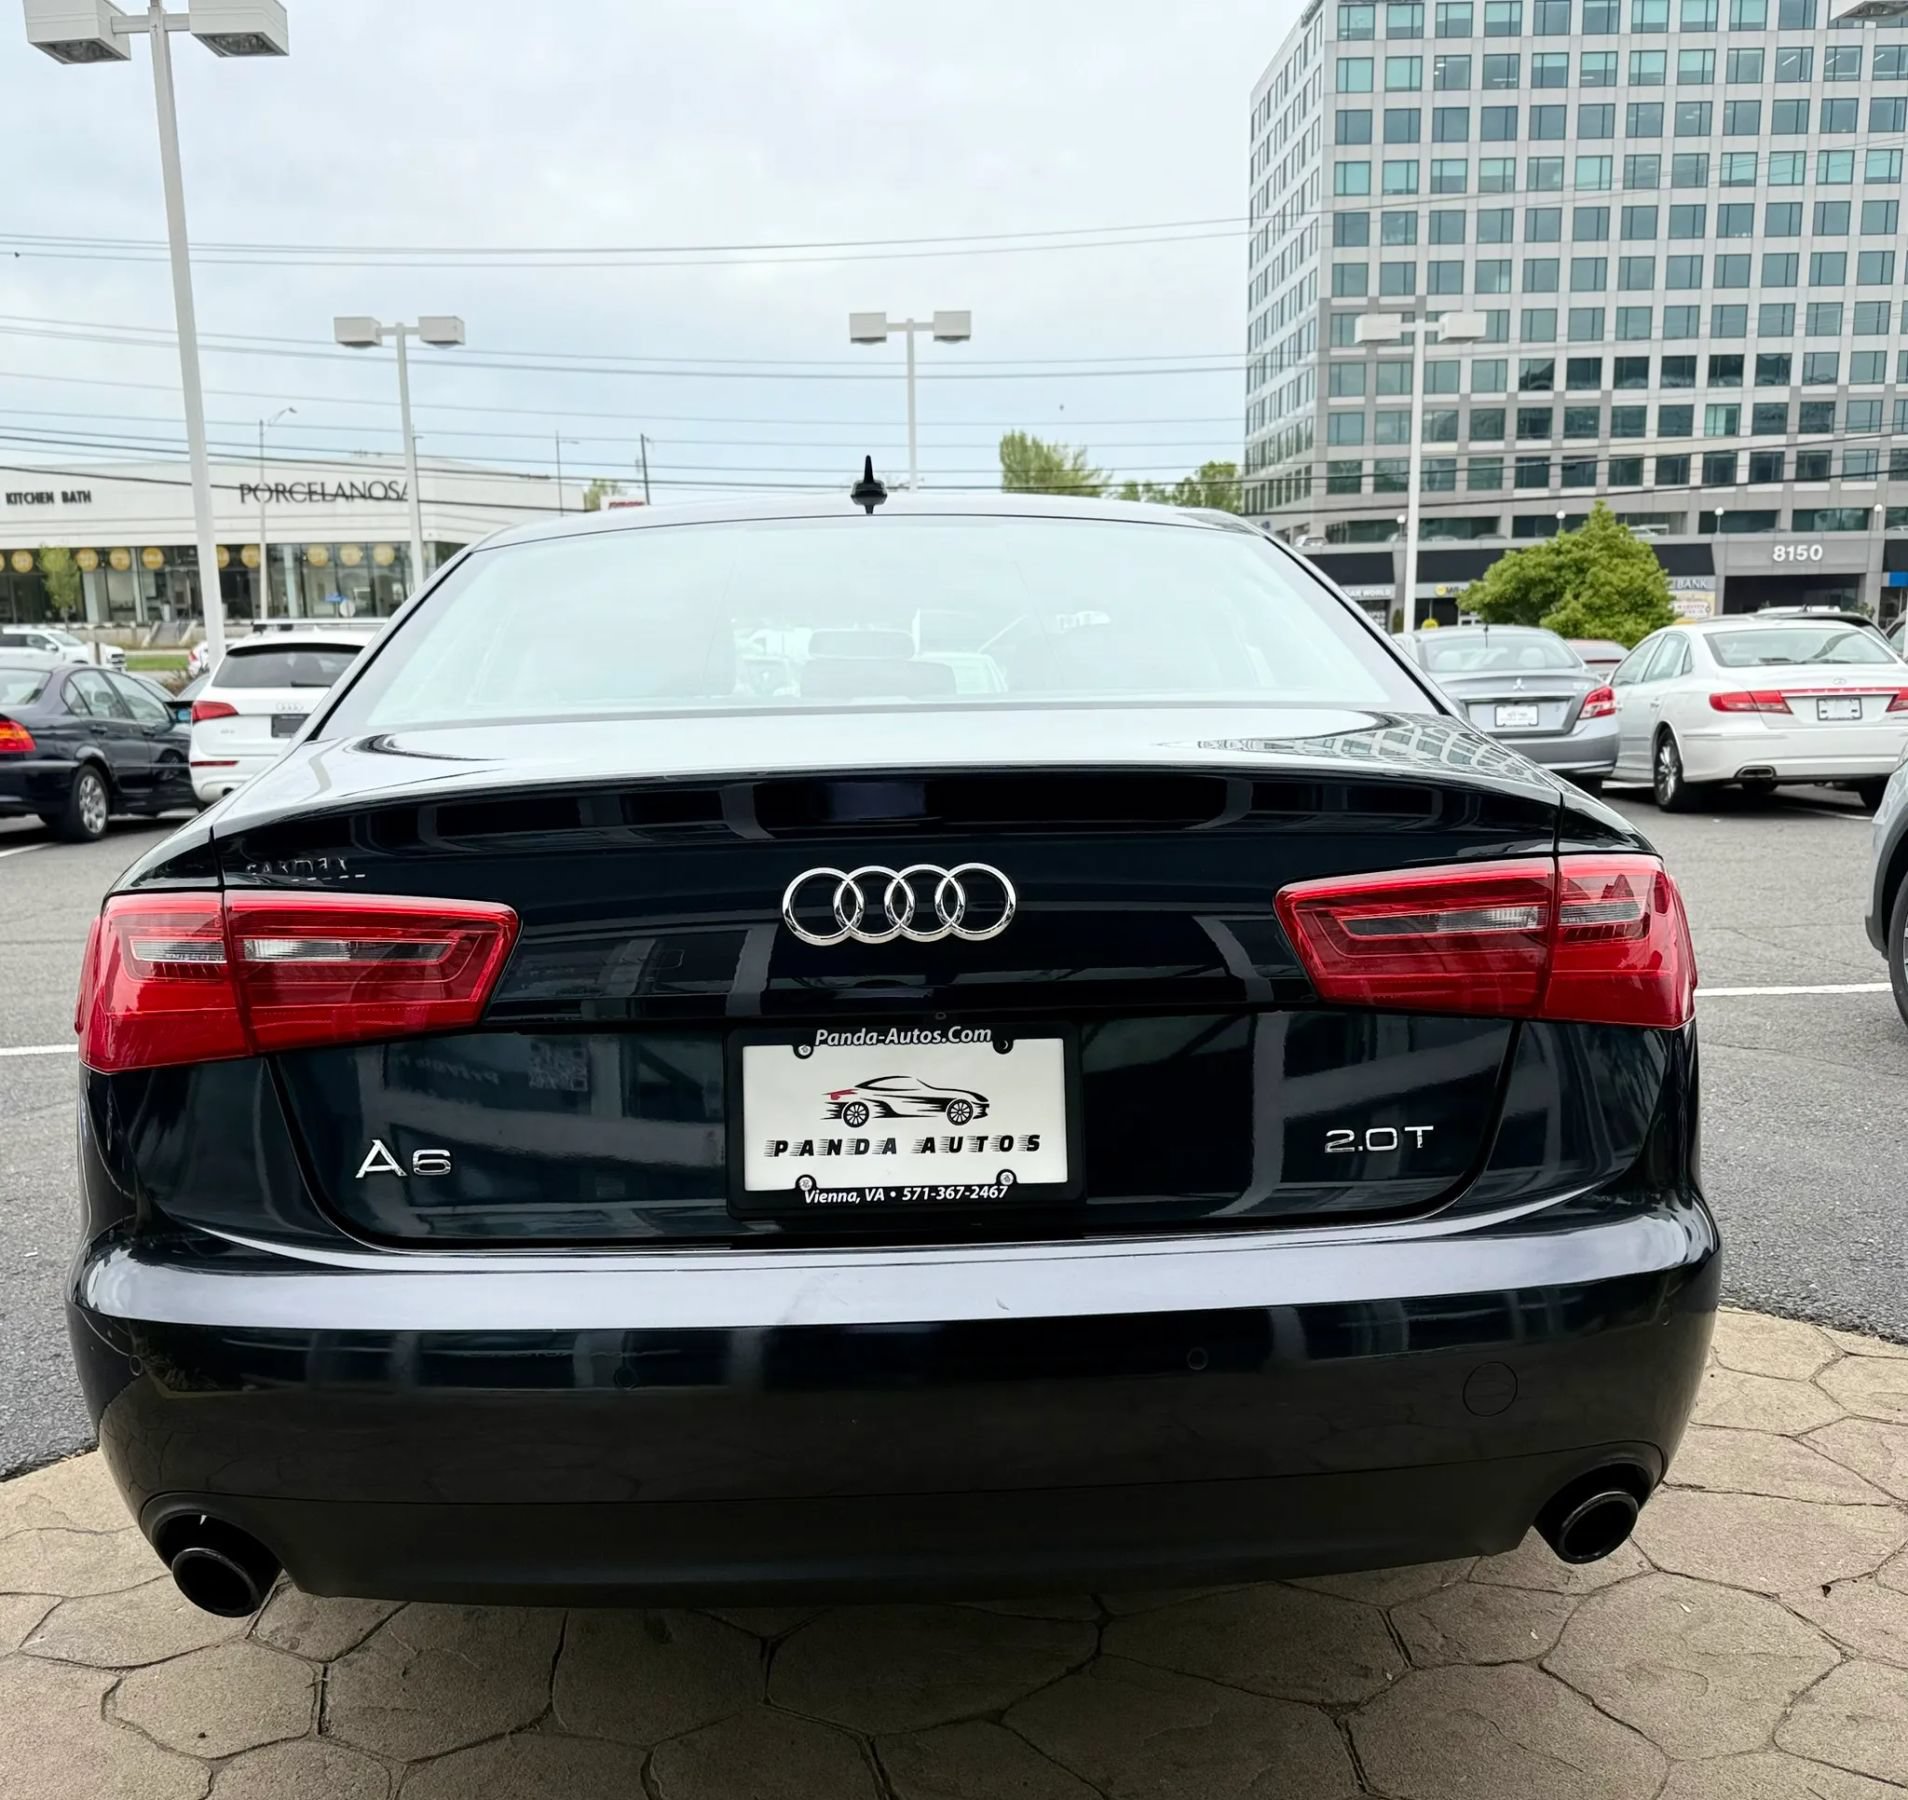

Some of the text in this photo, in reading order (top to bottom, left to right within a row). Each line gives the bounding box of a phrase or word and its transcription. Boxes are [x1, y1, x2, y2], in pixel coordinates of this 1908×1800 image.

[5, 489, 92, 505] KITCHEN BATH
[1772, 544, 1823, 562] 8150
[1677, 578, 1707, 590] BANK
[815, 1026, 992, 1046] Panda-Autos.Com
[764, 1134, 1041, 1158] PANDA AUTOS
[1324, 1125, 1434, 1153] 2.0T
[355, 1139, 452, 1179] A6
[805, 1185, 1009, 1204] Vienna, VA 571-367-2467
